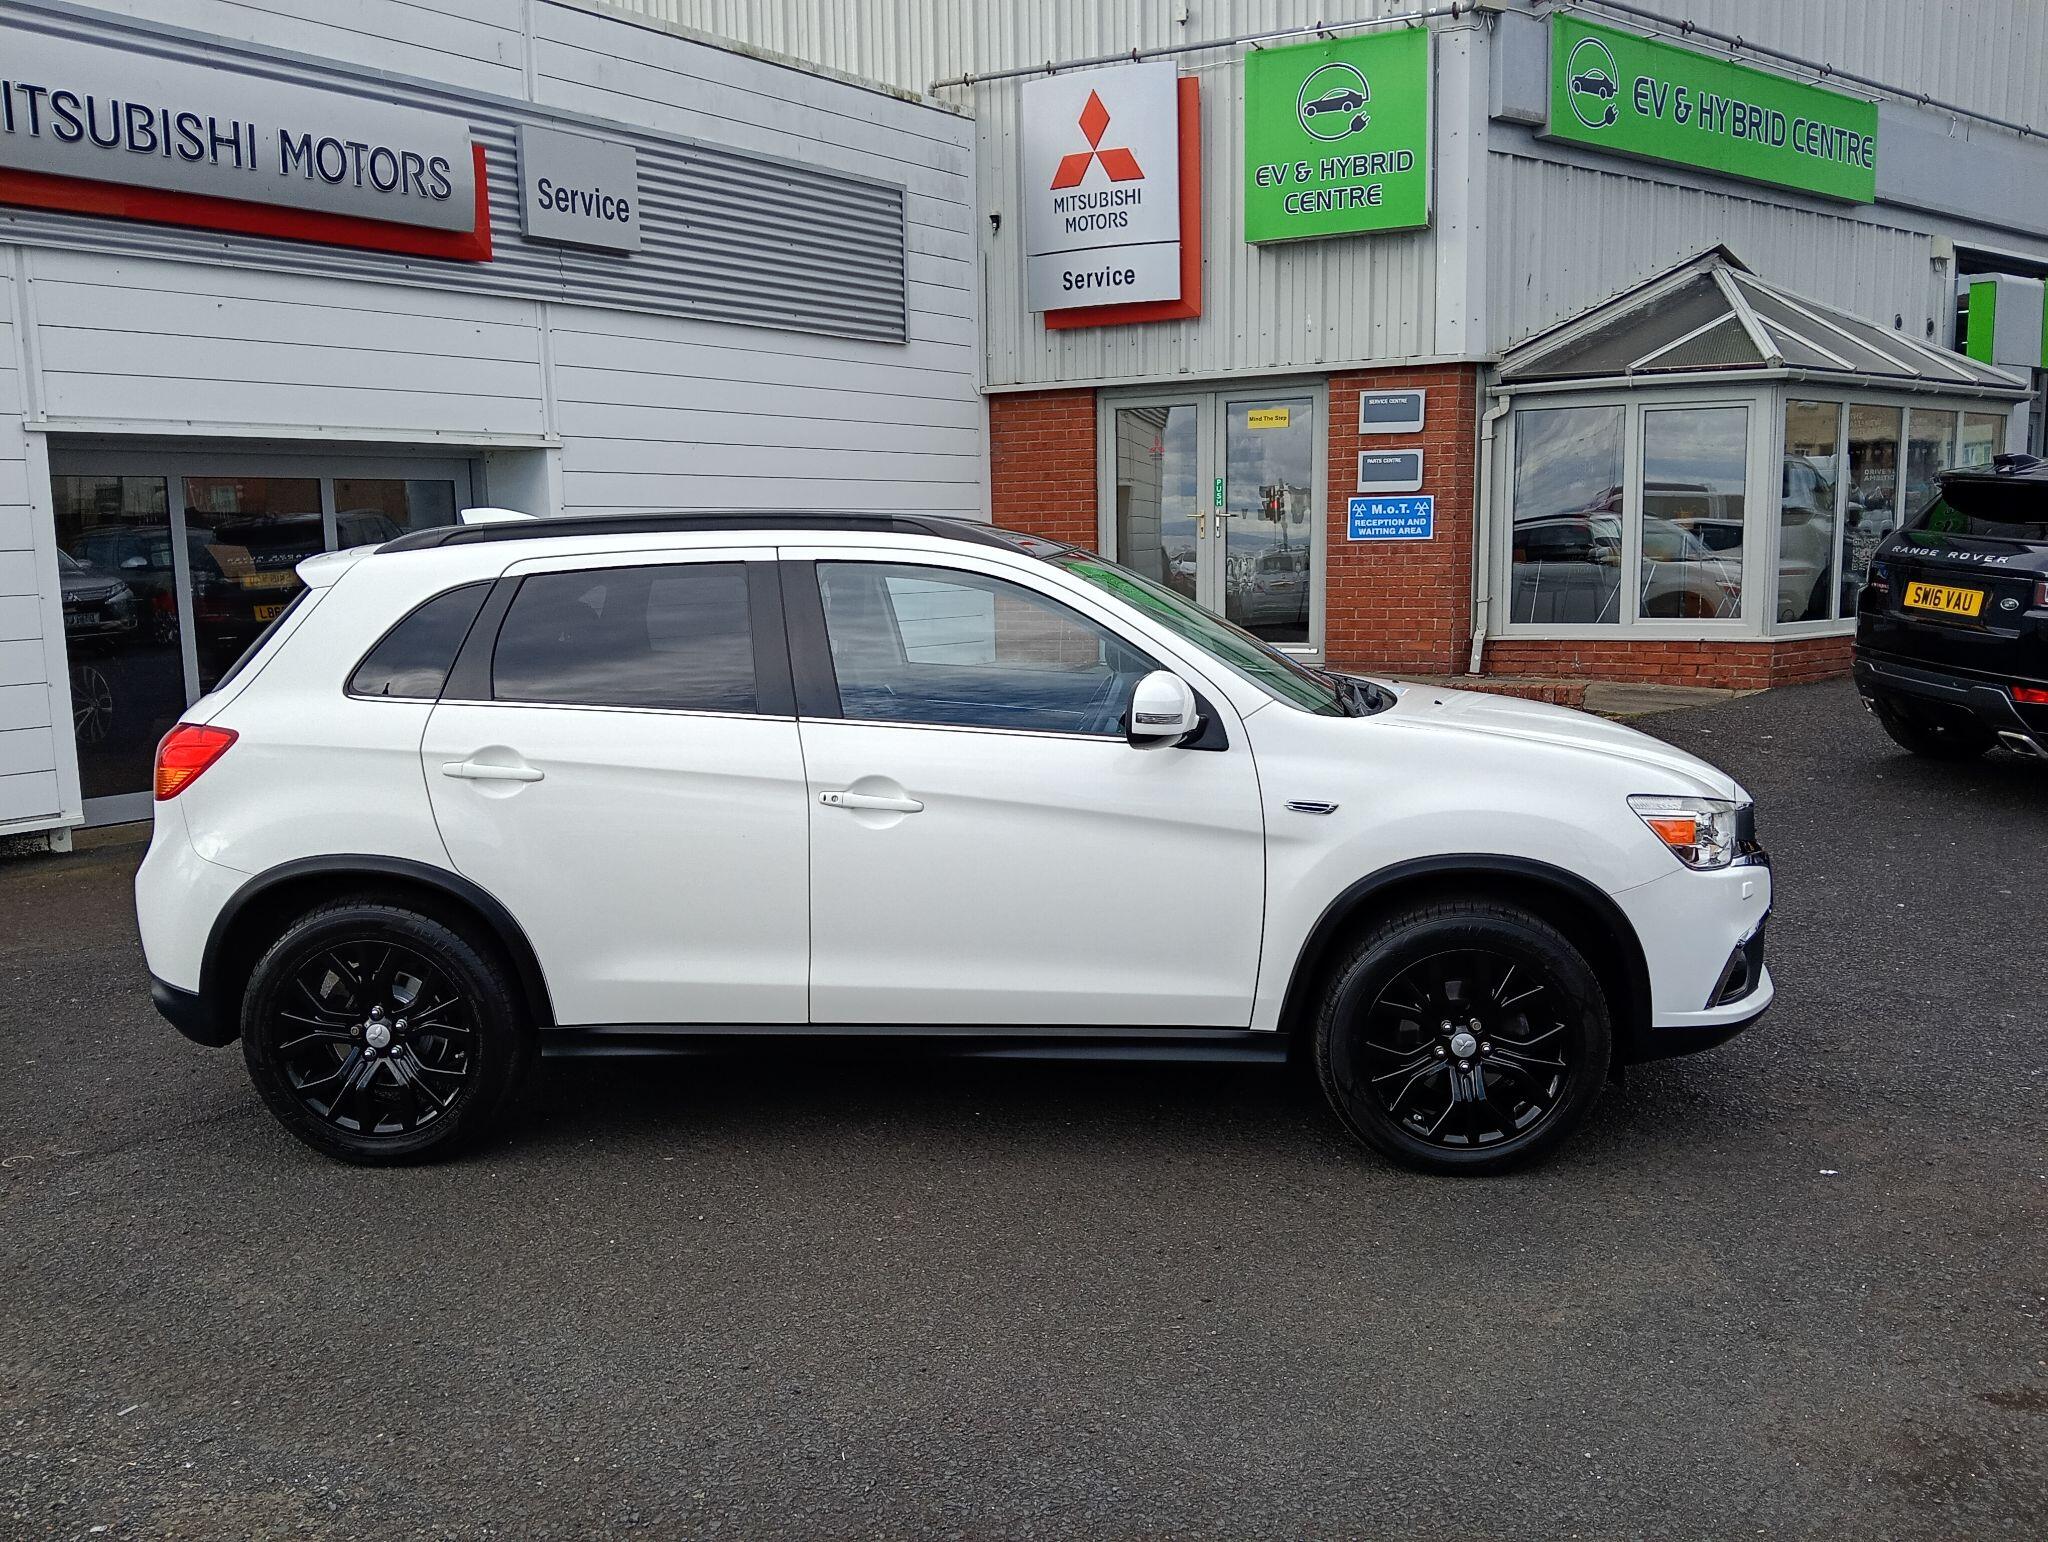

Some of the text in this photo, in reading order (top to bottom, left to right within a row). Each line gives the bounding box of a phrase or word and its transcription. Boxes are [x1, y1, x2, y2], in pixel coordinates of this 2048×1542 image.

[1632, 76, 1875, 170] EV & HYBRID CENTRE
[278, 128, 454, 200] MOTORS
[1255, 149, 1414, 188] EV & HYBRID
[537, 177, 631, 224] Service
[1053, 187, 1142, 214] MITSUBISHI
[1283, 183, 1383, 215] CENTRE
[1065, 210, 1129, 234] MOTORS
[1062, 264, 1136, 292] Service
[1371, 503, 1410, 514] M.o.T.
[1354, 518, 1427, 527] RECEPTION AND
[1358, 527, 1396, 535] WAITING
[1891, 545, 2009, 563] RANGE ROVER
[1913, 586, 1942, 607] SW16
[1946, 590, 1974, 611] VAU
